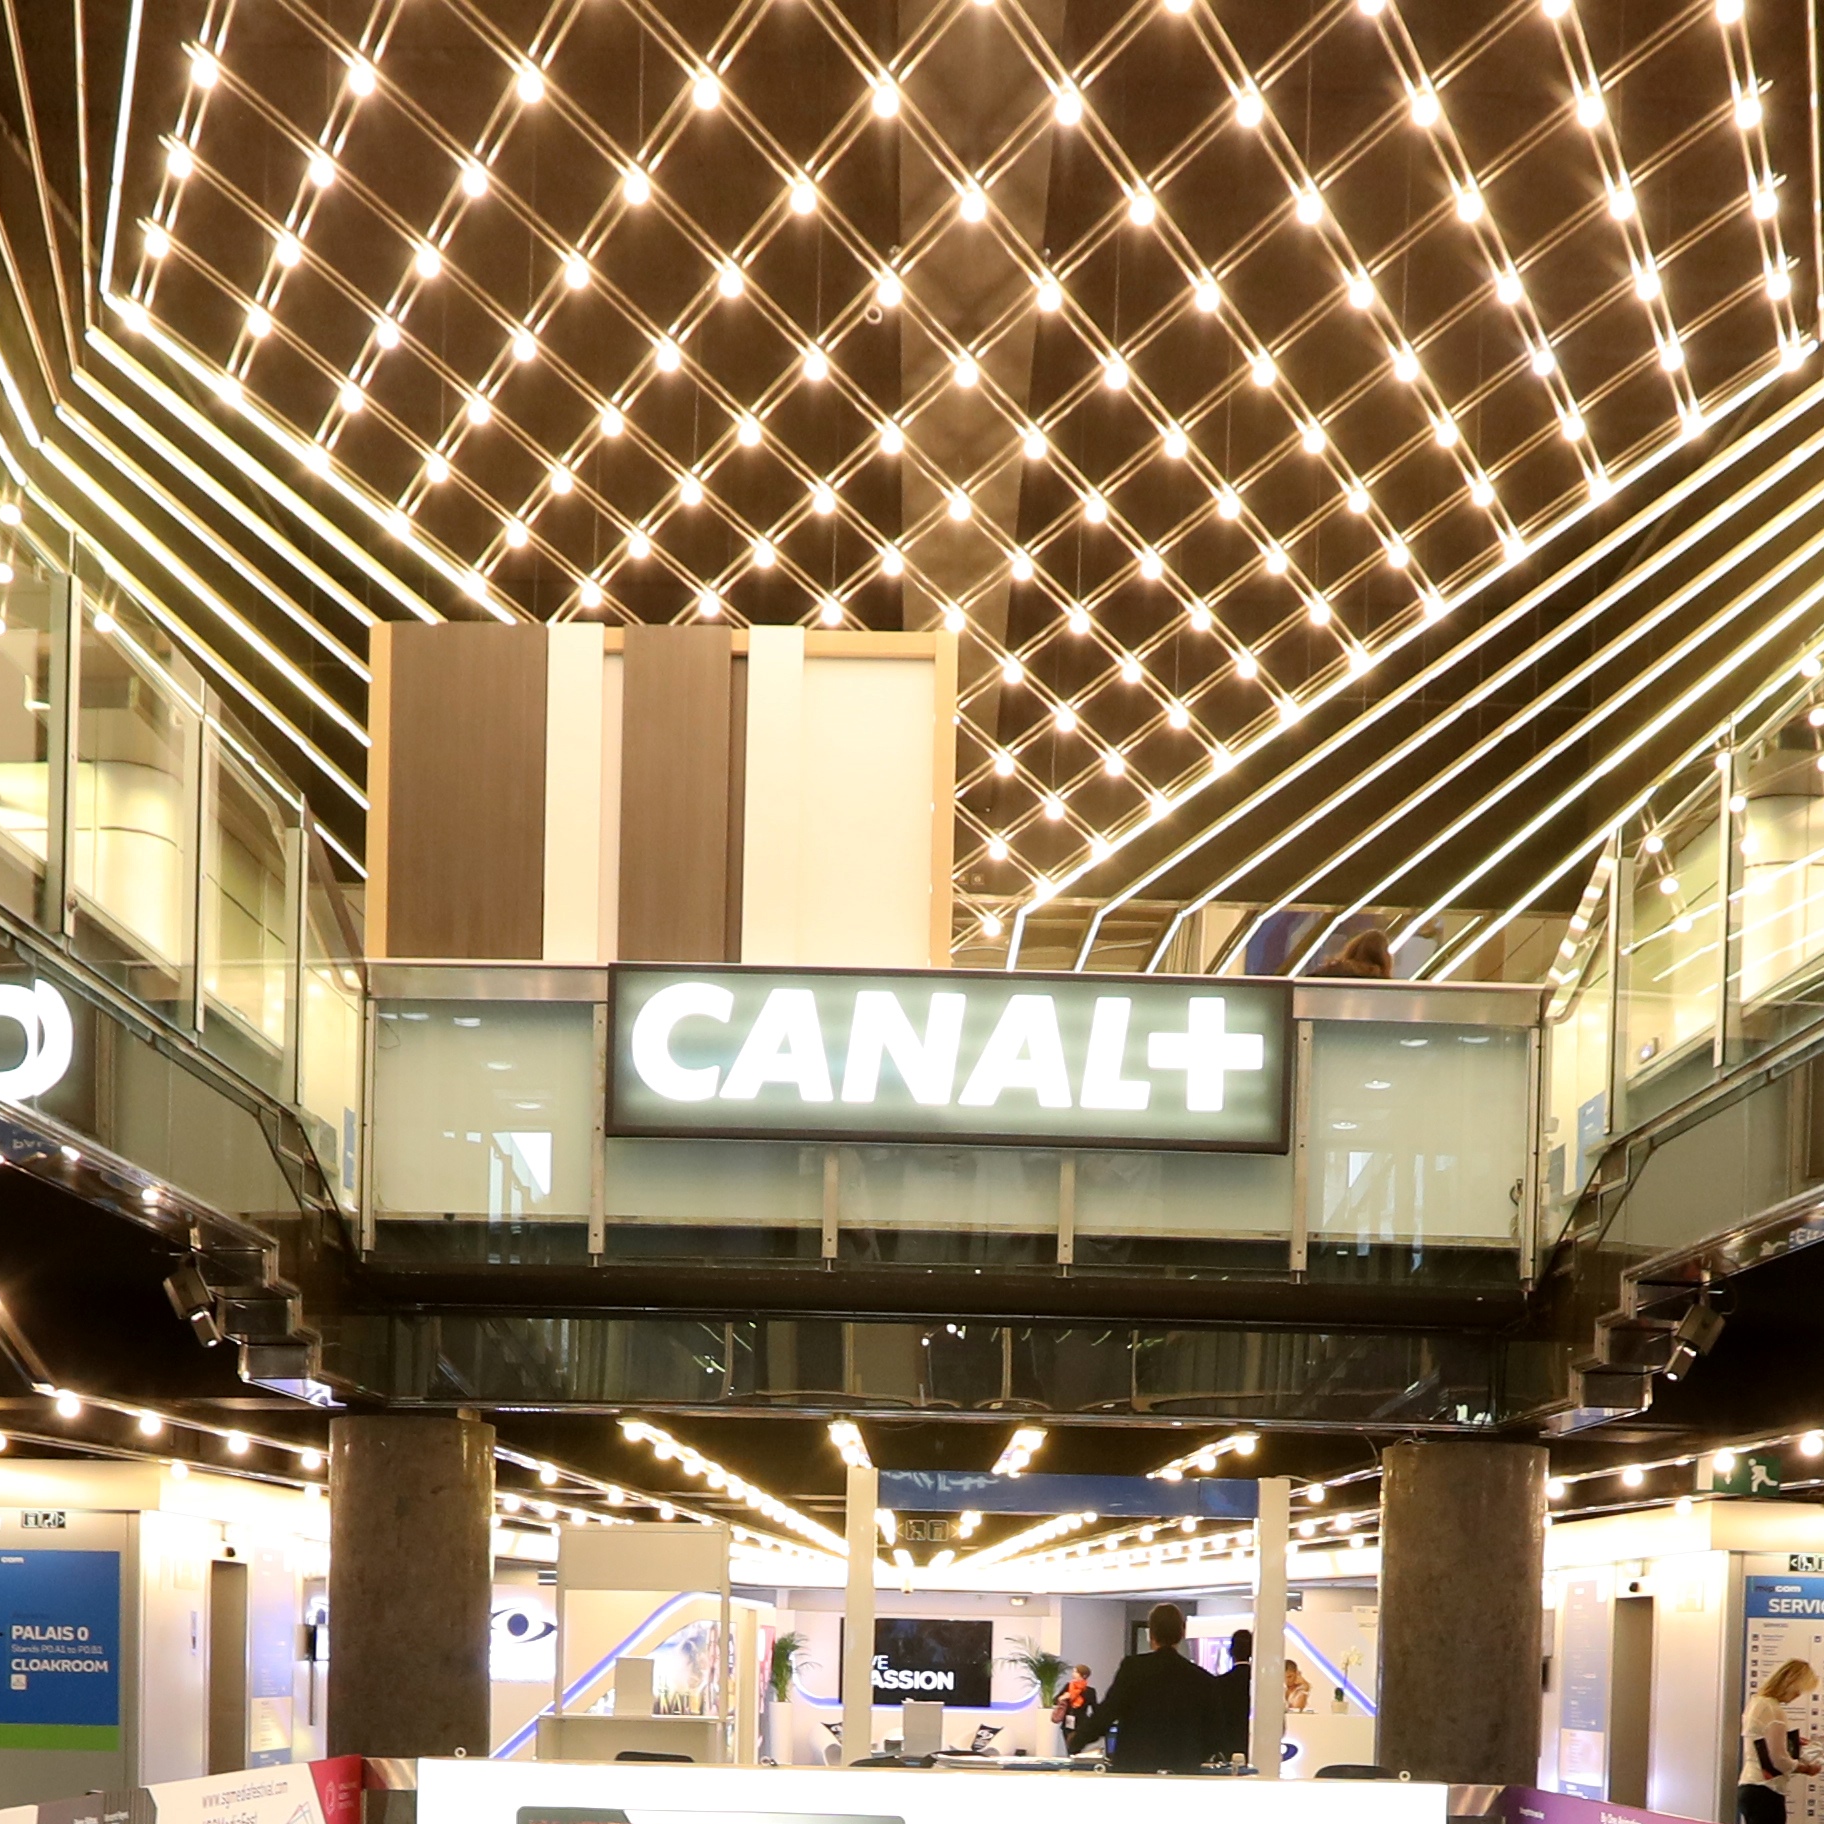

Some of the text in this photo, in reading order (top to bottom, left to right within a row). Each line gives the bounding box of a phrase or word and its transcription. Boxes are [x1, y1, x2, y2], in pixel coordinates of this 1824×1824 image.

[631, 981, 1264, 1112] CANAL+
[11, 1624, 74, 1641] PALAIS
[11, 1658, 109, 1674] CLOAKROOM
[871, 1670, 955, 1690] ASSION
